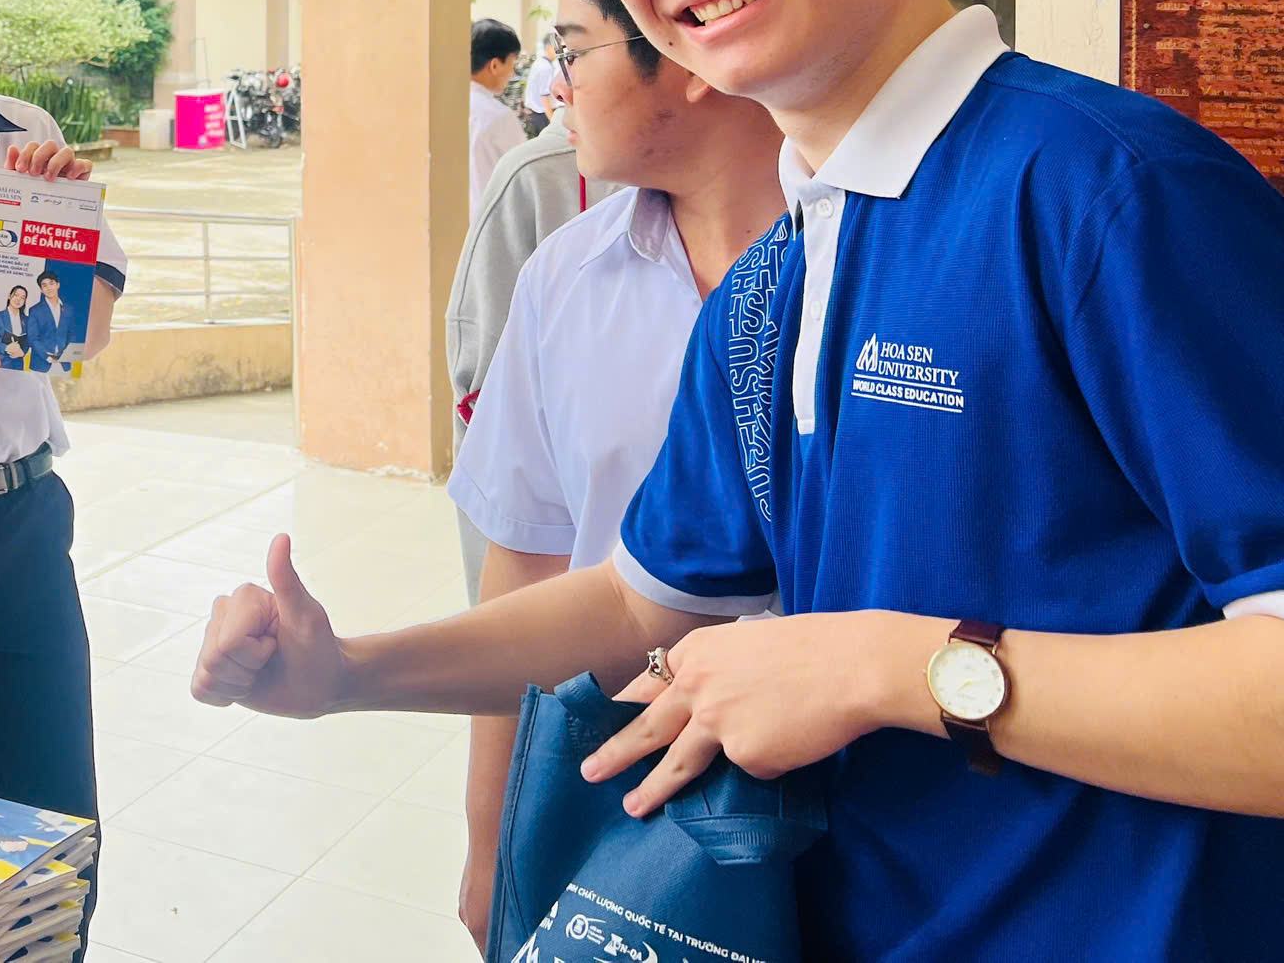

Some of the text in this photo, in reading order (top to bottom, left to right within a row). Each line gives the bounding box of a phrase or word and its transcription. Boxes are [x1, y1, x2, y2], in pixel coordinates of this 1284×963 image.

[25, 224, 78, 241] KHÁC BIỆT
[880, 341, 933, 364] HOA SEN
[878, 360, 959, 386] UNIVERSITY
[852, 379, 964, 408] WORLD CLASS EDUCATION
